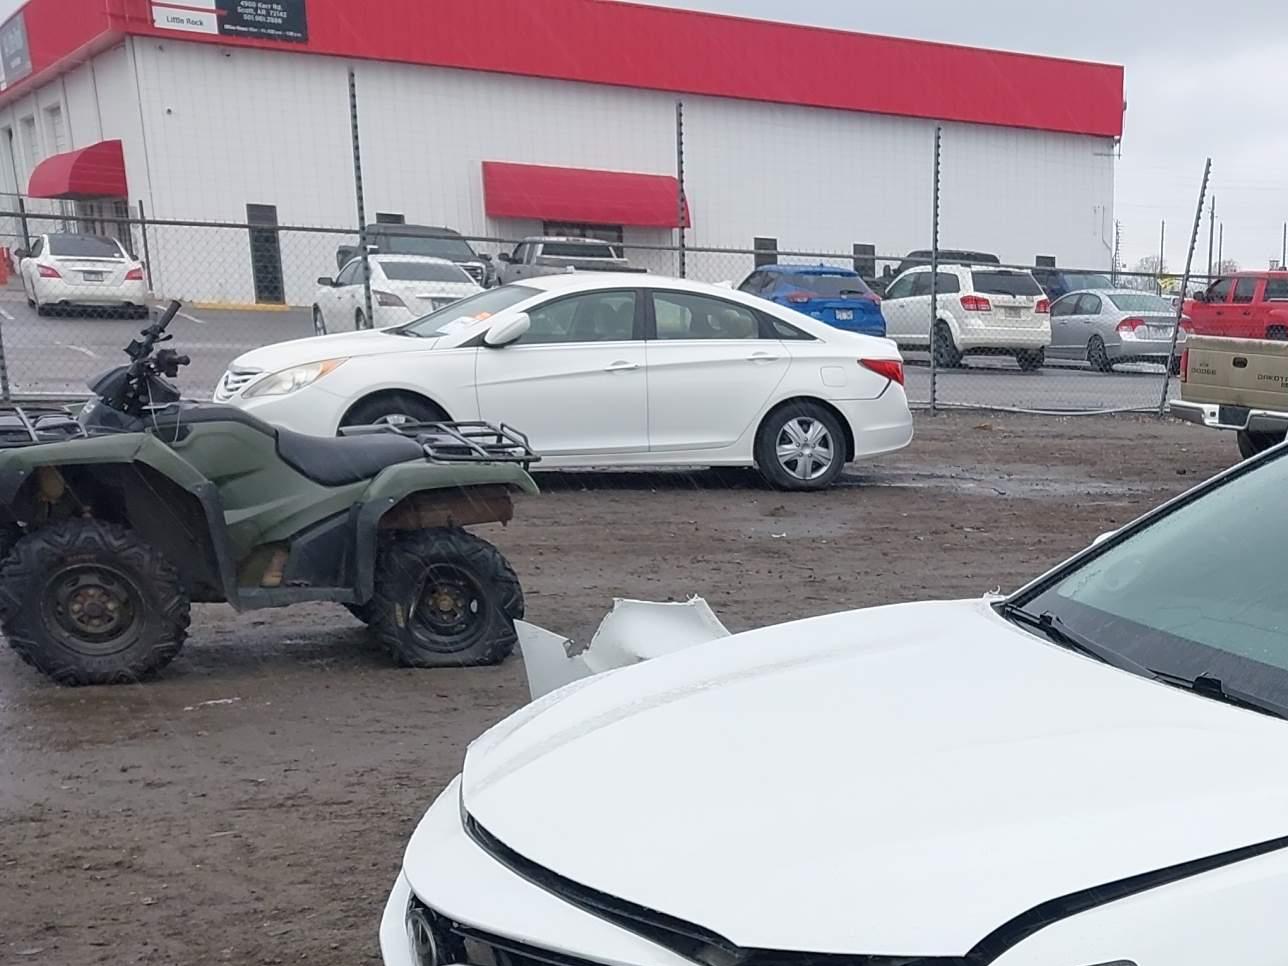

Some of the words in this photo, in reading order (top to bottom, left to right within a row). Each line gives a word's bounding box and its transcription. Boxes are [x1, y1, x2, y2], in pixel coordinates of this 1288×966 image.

[166, 15, 185, 25] Little
[186, 18, 204, 26] Rock
[1191, 367, 1216, 376] DODGE
